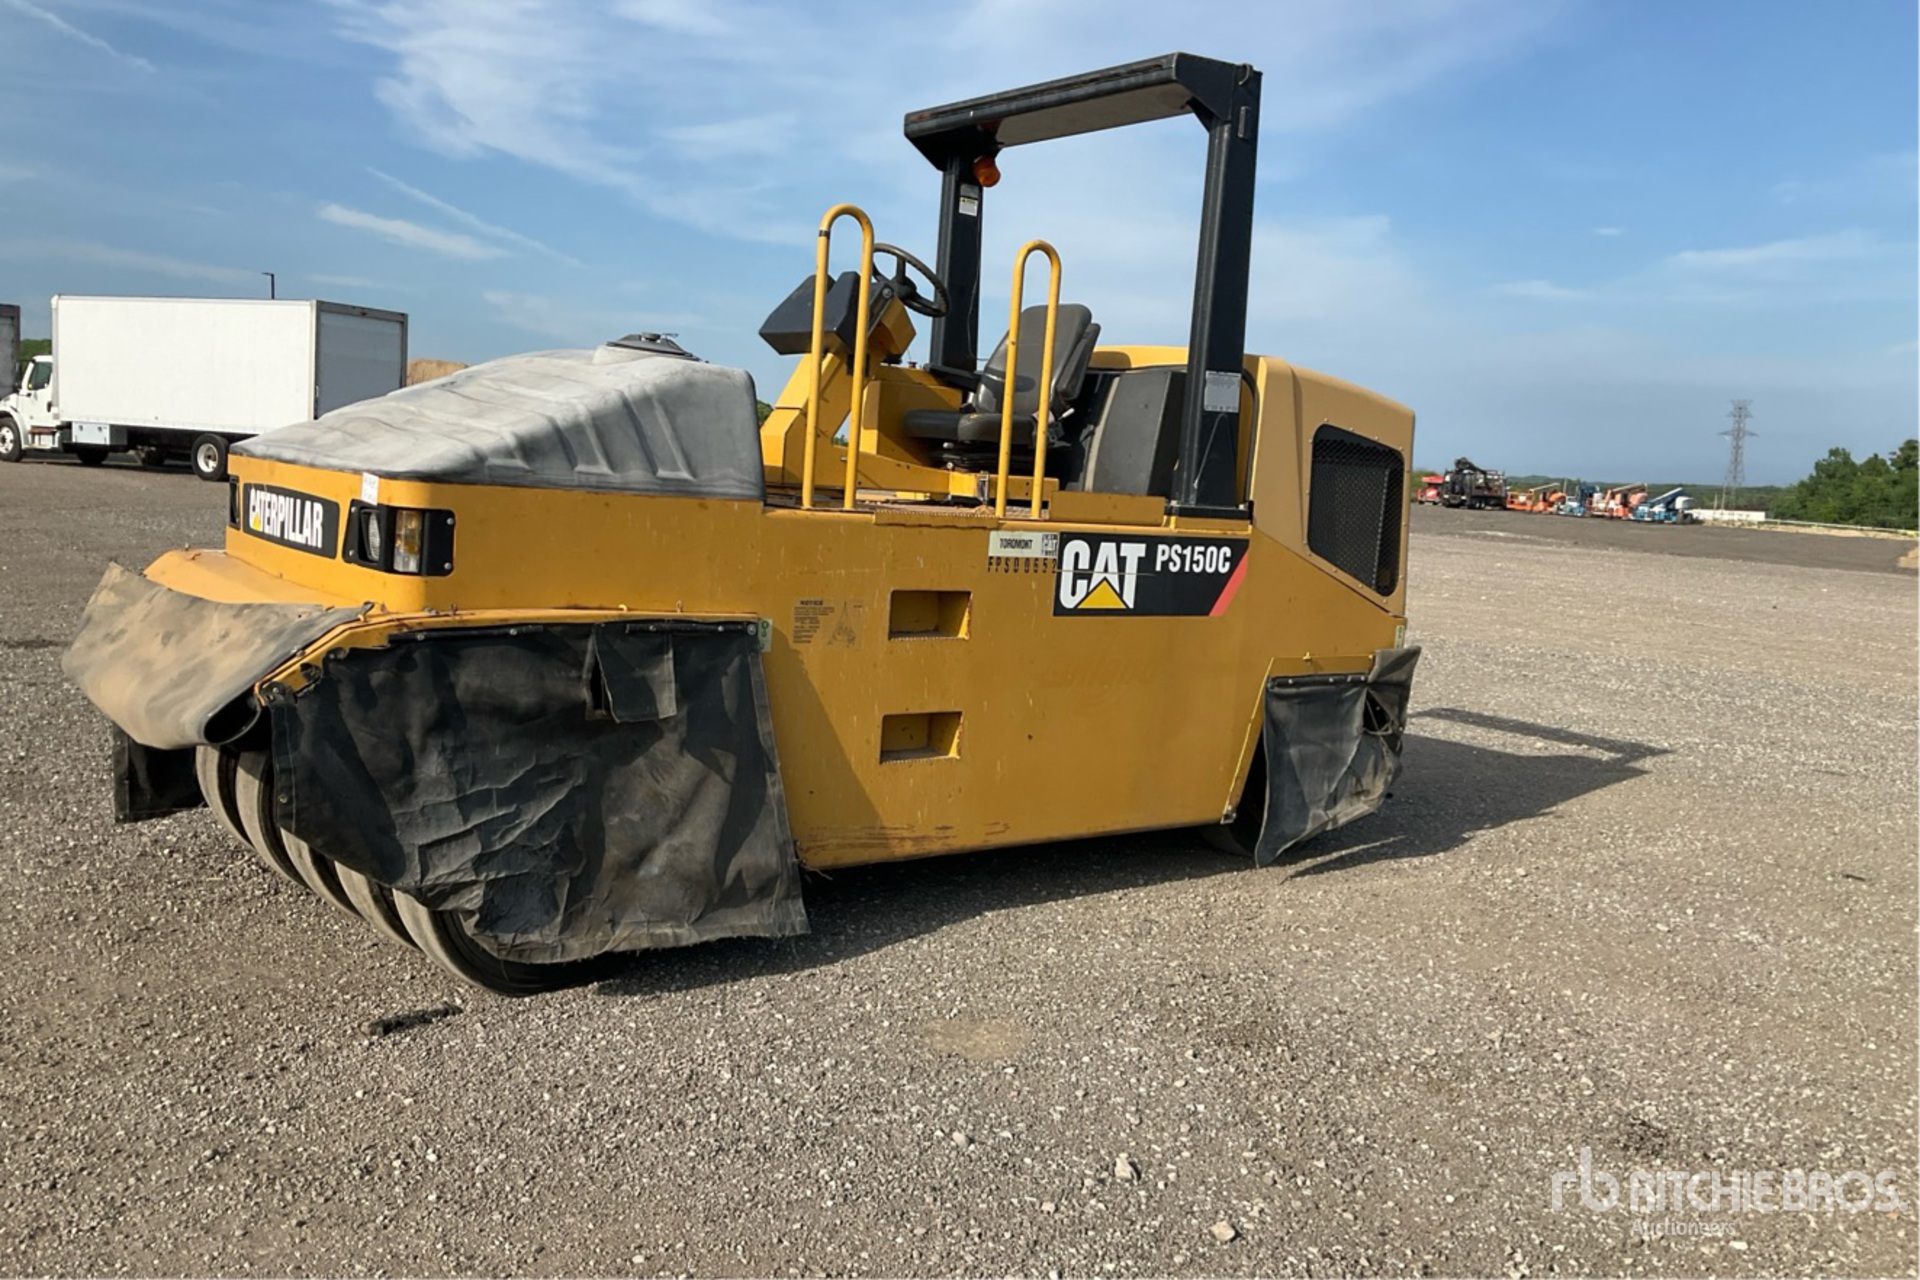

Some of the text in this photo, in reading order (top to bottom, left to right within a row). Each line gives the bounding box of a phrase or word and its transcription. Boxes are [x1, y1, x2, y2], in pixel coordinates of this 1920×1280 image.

[250, 488, 323, 548] CATERPILLAR
[1060, 540, 1146, 609] CAT
[1156, 544, 1232, 573] PS150C
